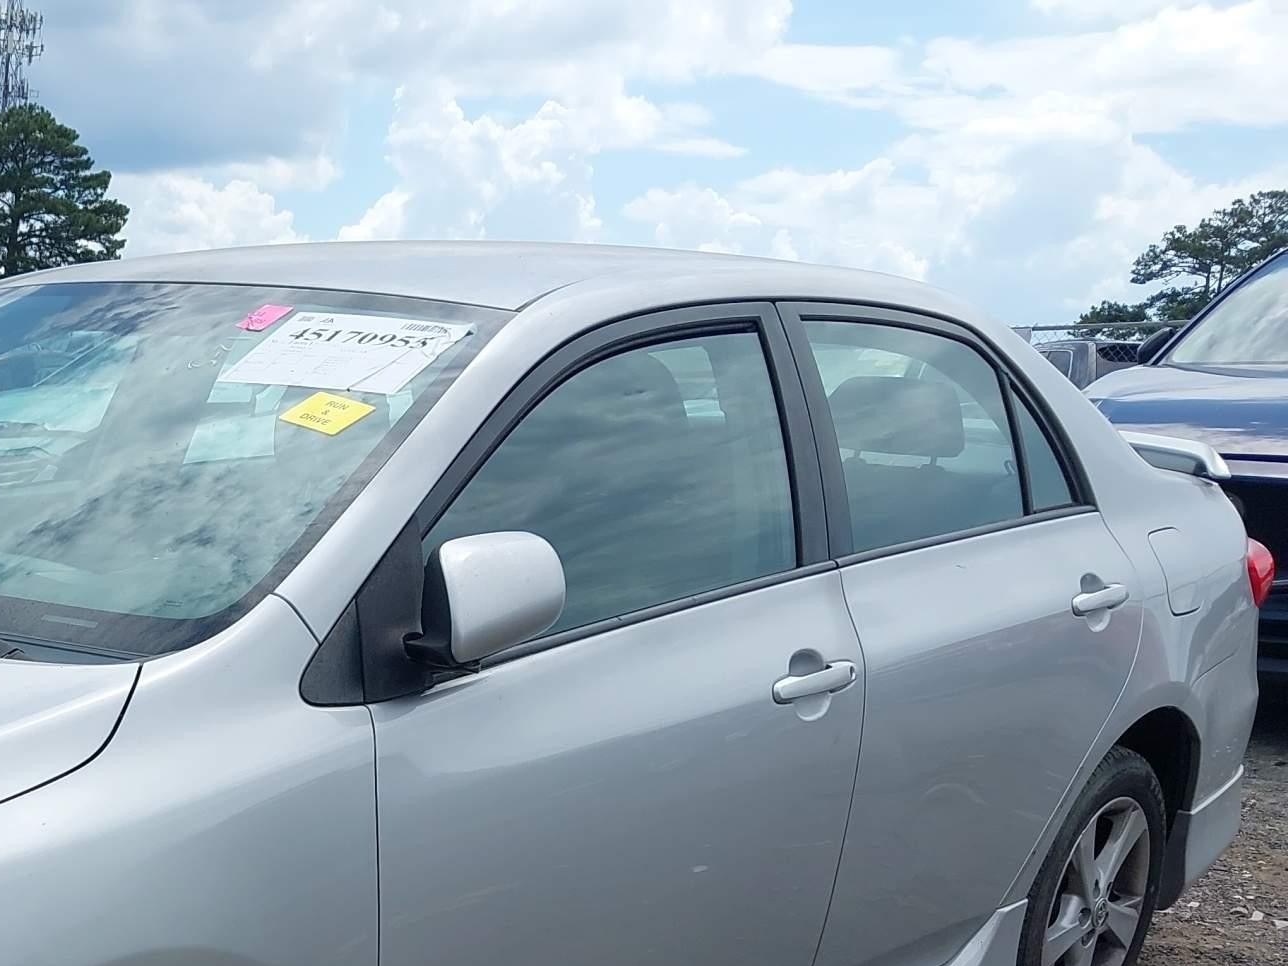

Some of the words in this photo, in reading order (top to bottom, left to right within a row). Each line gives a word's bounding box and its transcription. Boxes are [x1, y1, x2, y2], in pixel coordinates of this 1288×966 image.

[289, 327, 435, 349] 45170955
[324, 400, 350, 411] RUN
[299, 412, 333, 426] DRIVE
